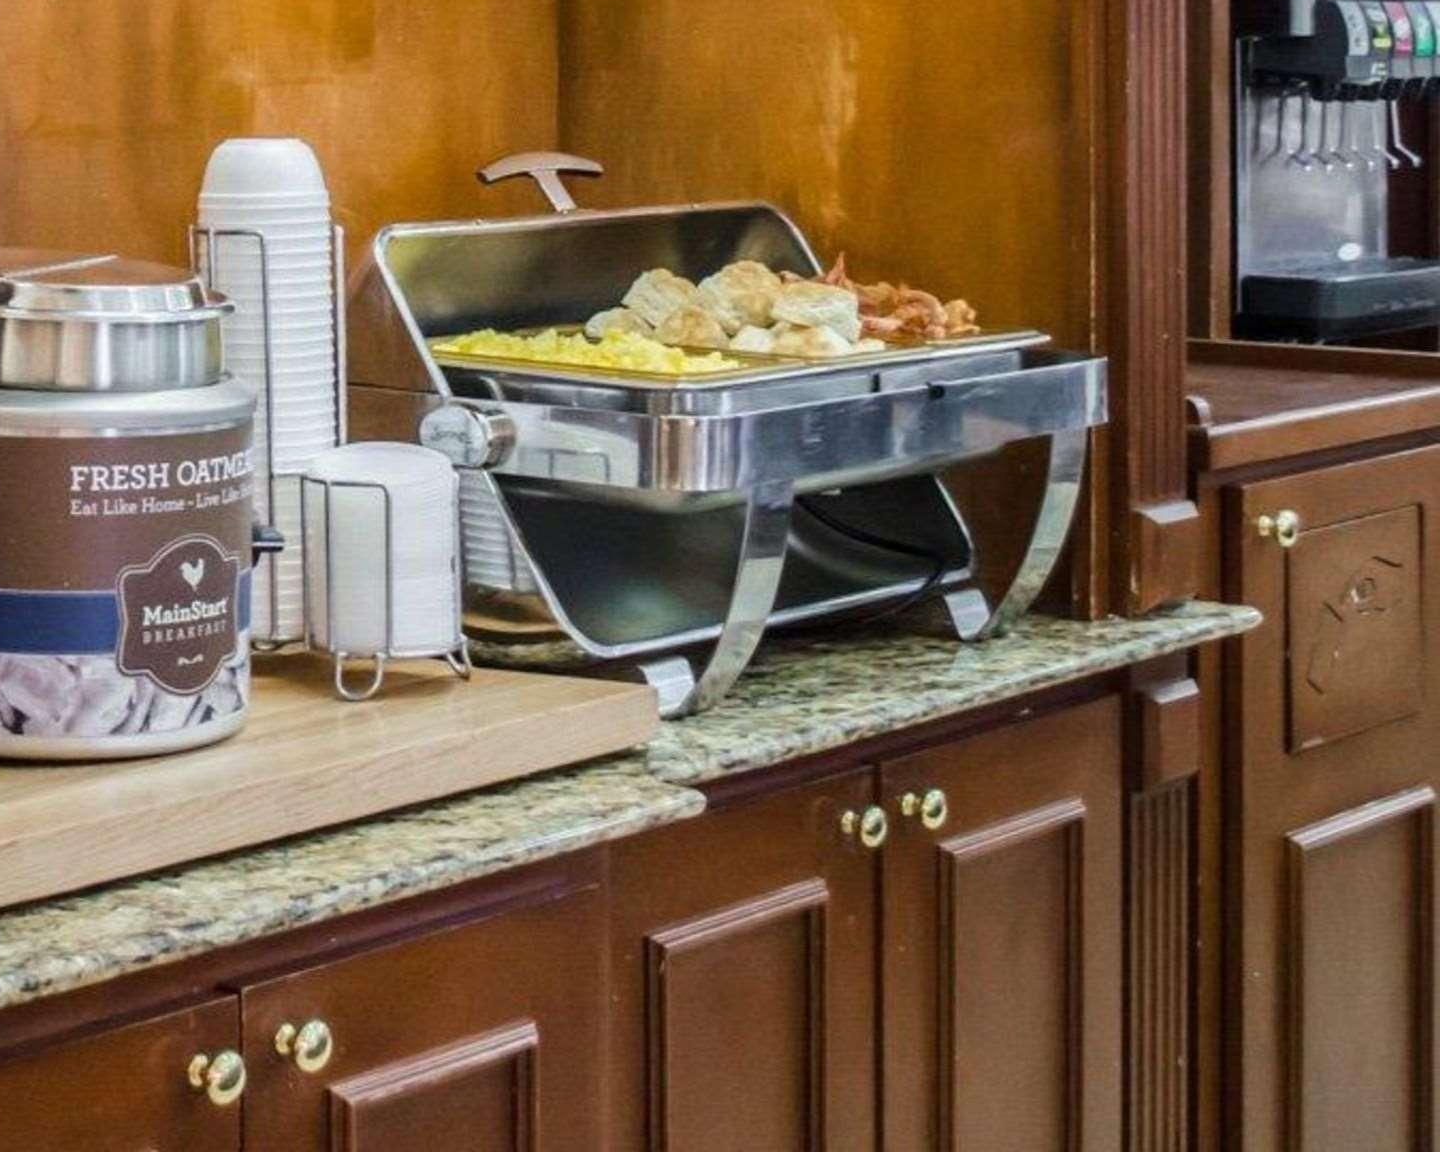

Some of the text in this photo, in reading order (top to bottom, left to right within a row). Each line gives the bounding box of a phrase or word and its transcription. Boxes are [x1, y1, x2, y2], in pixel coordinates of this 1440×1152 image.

[70, 463, 170, 492] FRESH
[70, 500, 97, 515] Eat
[103, 499, 137, 515] Like
[142, 497, 184, 513] Home
[196, 493, 220, 508] Live
[142, 597, 229, 626] MainStart
[143, 620, 226, 645] BREAKFAST
